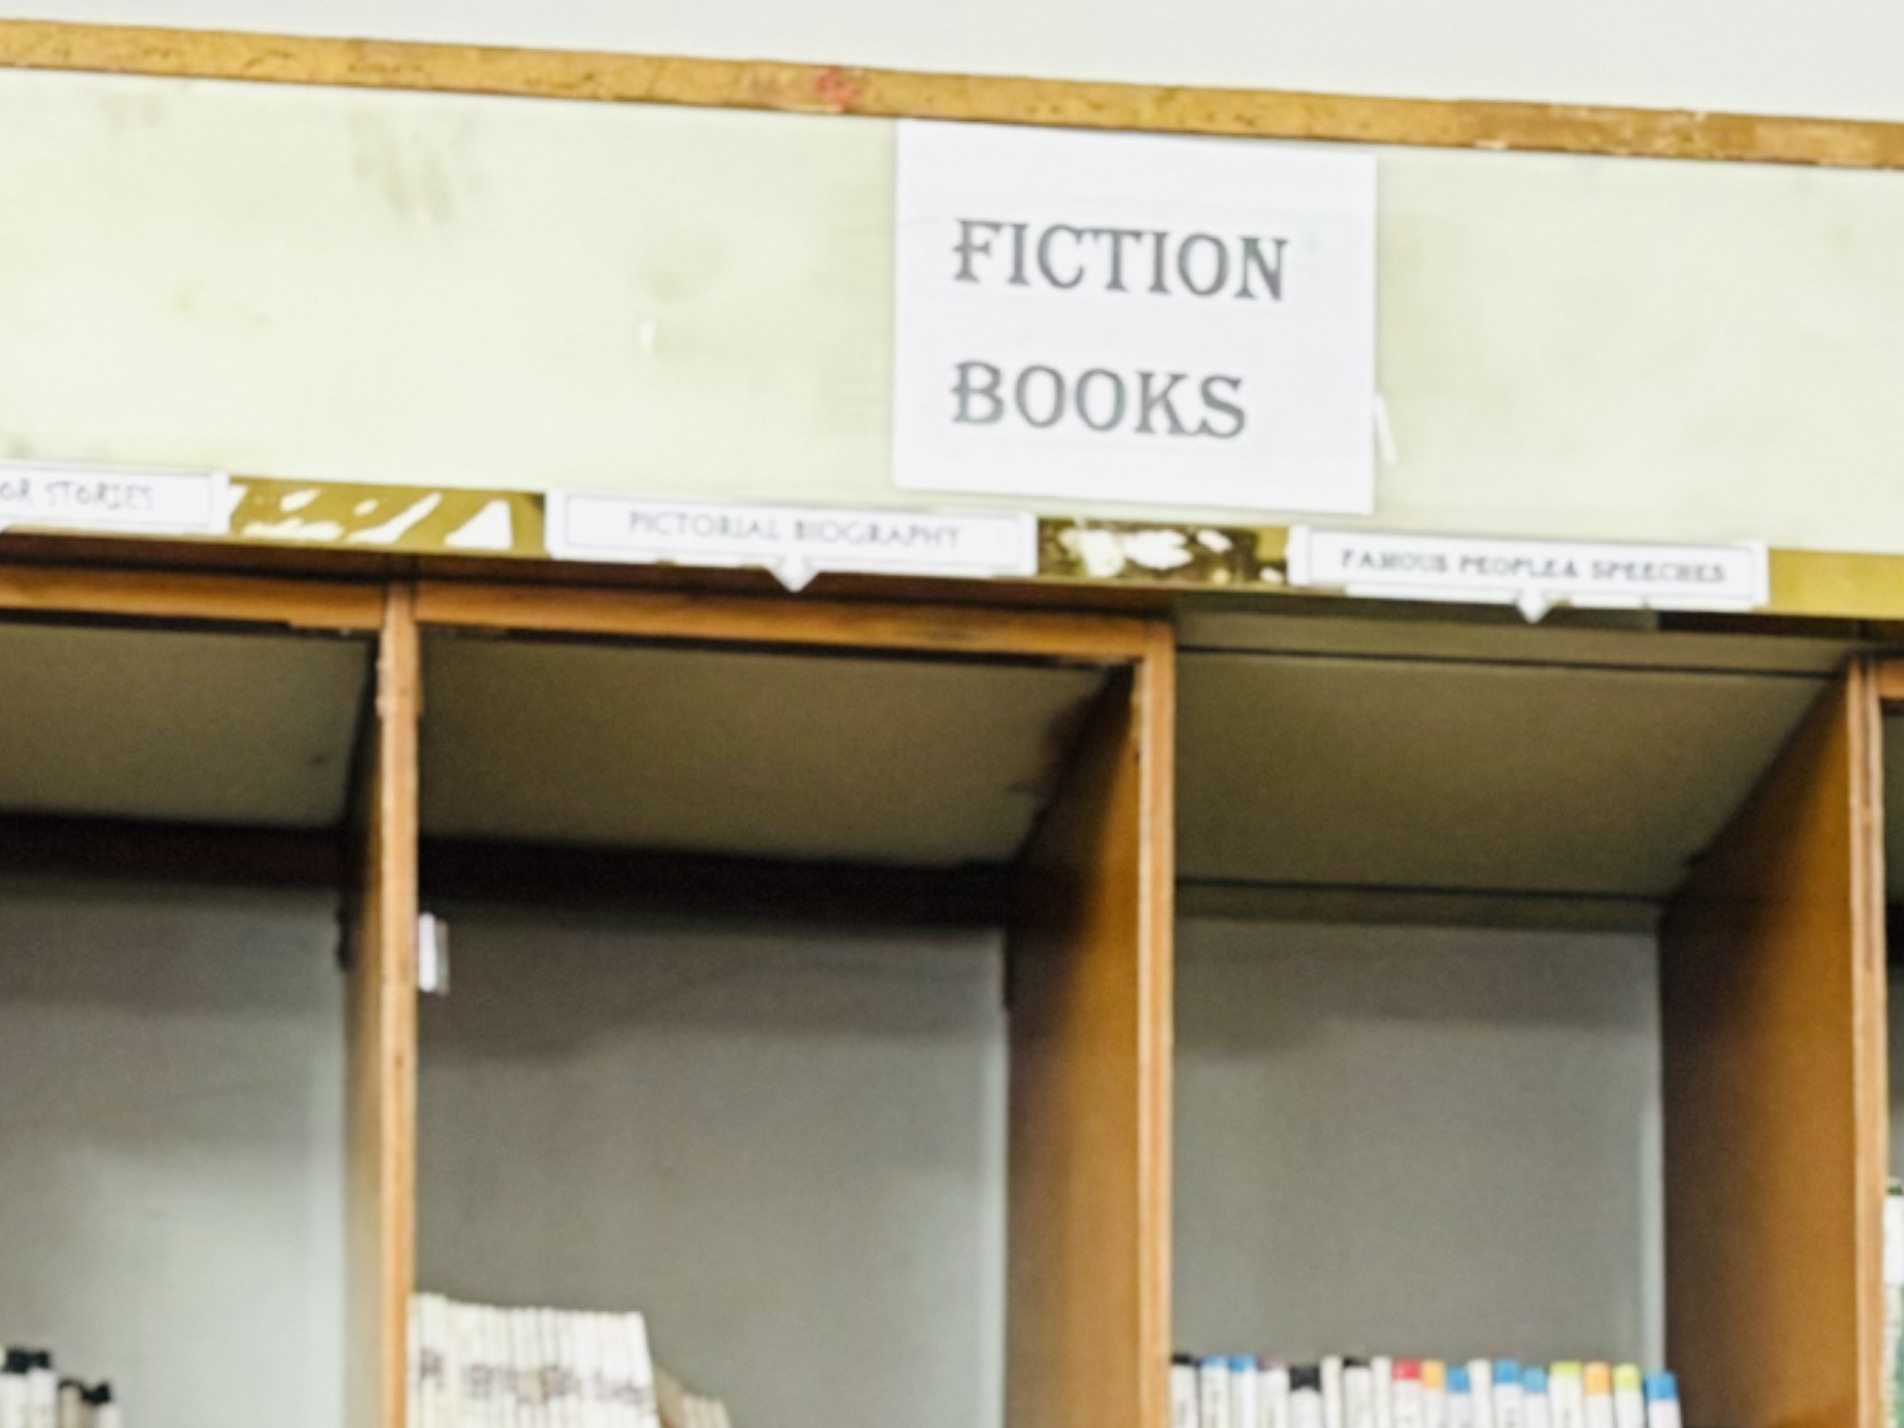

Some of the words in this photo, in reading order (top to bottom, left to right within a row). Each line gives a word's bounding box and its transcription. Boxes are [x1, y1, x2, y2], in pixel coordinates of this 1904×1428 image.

[952, 218, 1289, 302] FICTION
[950, 361, 1247, 439] BOOKS
[45, 480, 154, 510] STORIES
[629, 510, 781, 542] PICTORIAL
[795, 518, 961, 549] BIOGRAPHY
[1342, 548, 1449, 574] FAMOUS
[1592, 559, 1727, 584] SPEECHES
